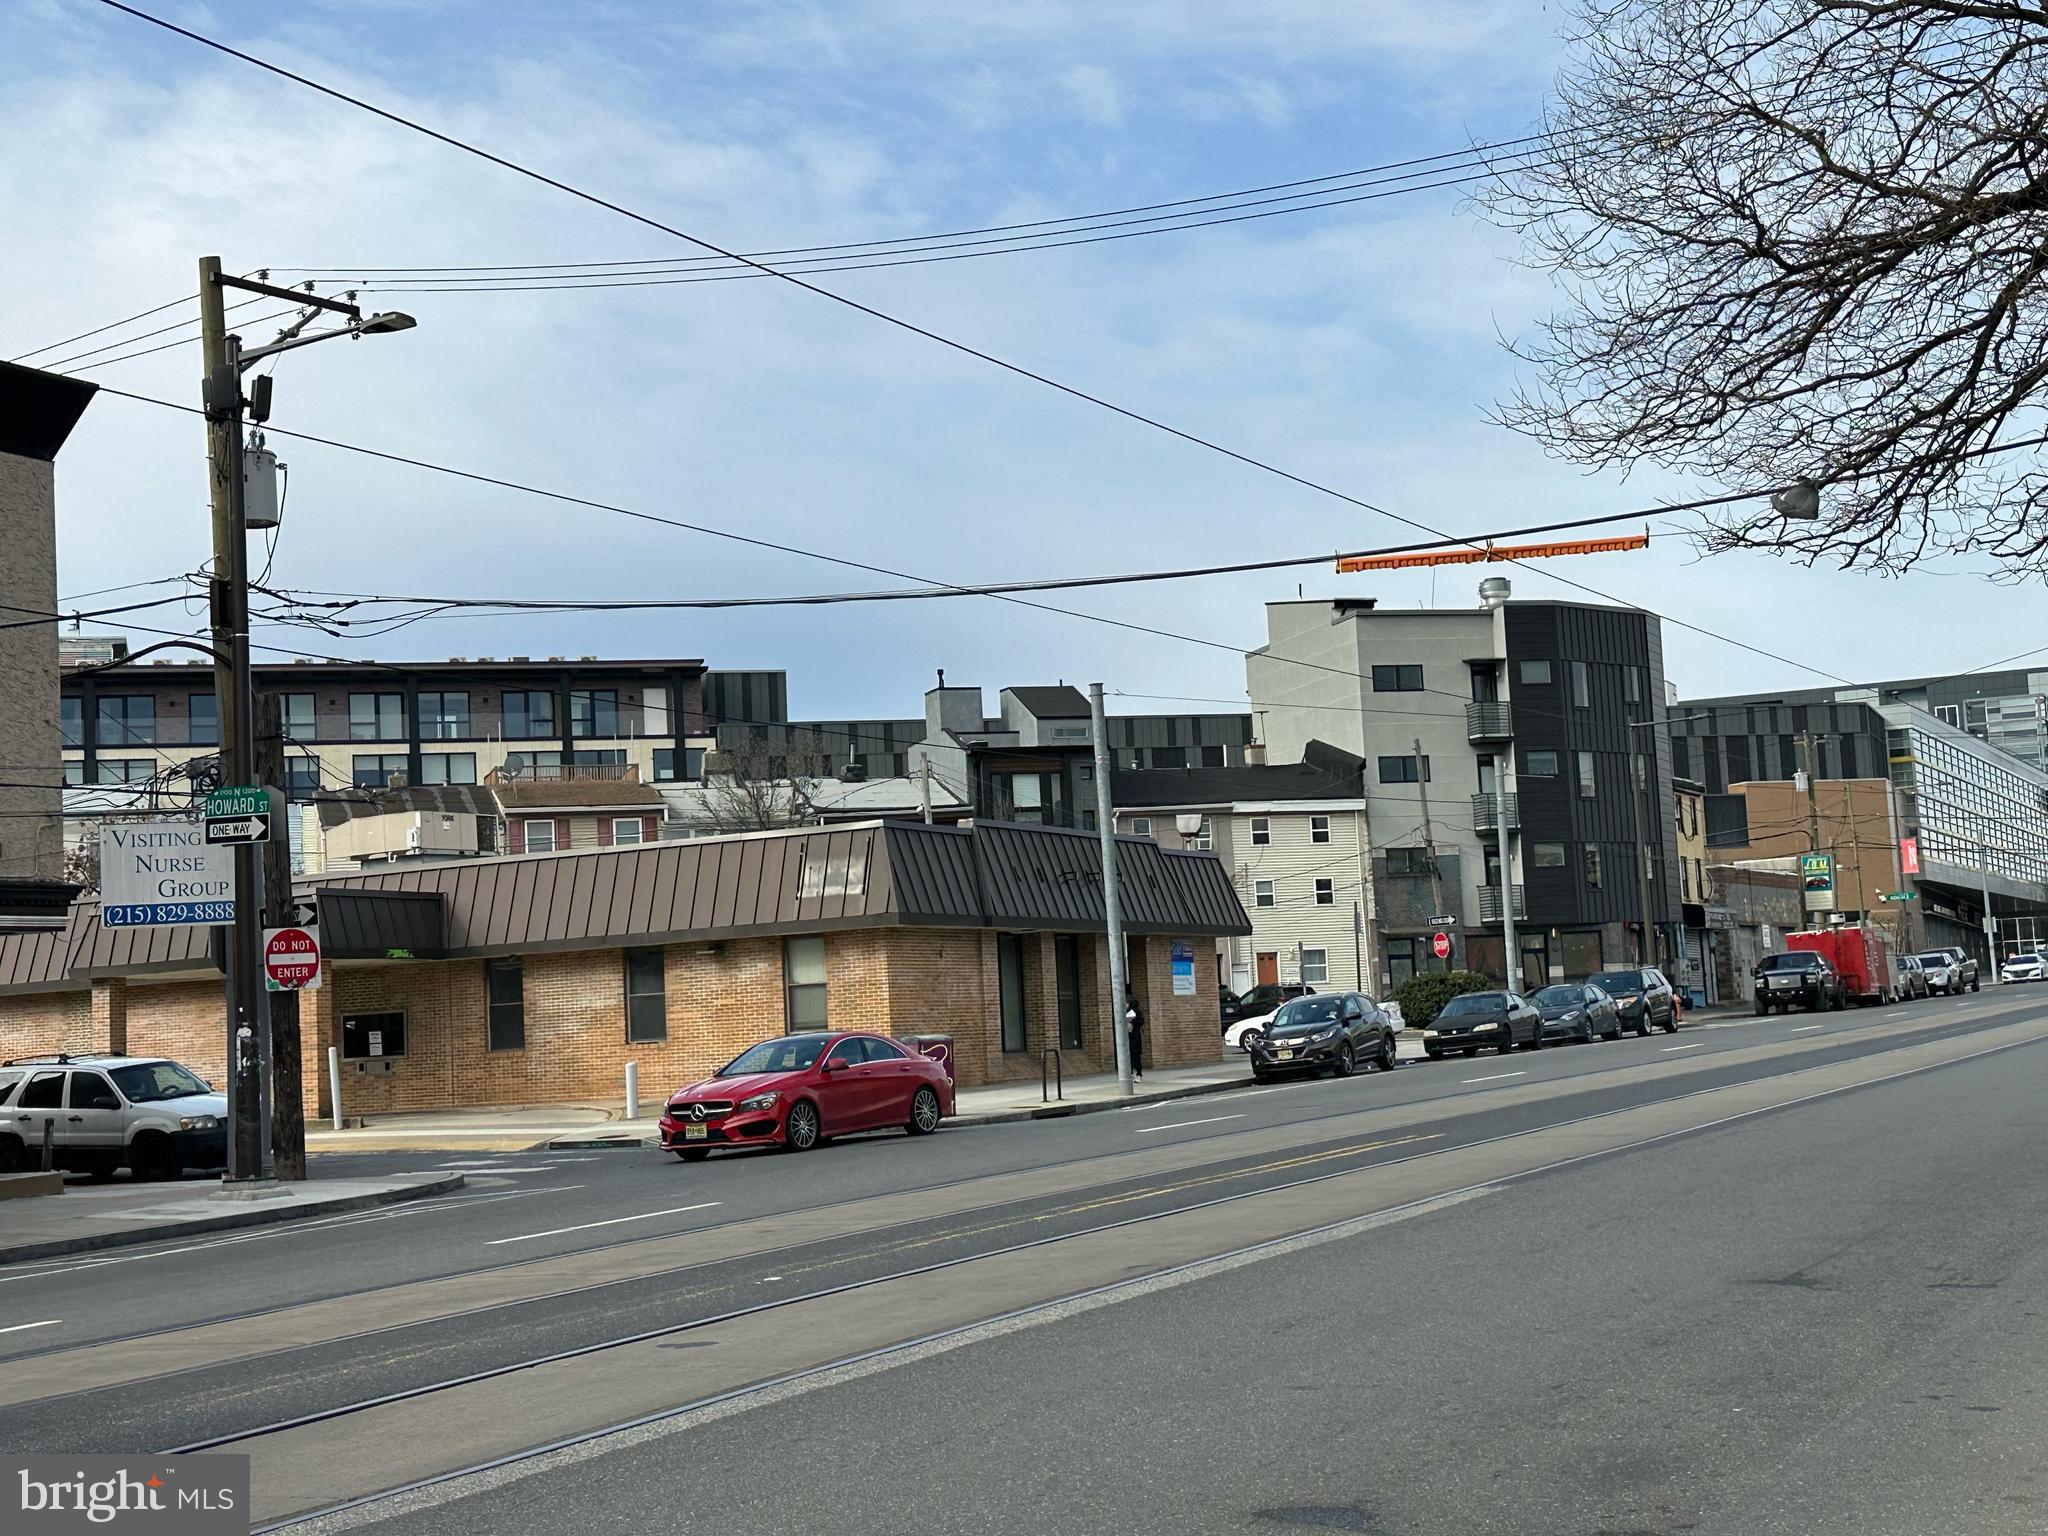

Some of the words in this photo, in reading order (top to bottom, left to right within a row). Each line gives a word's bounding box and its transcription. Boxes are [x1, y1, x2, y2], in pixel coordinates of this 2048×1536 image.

[207, 797, 255, 815] HOWARD
[259, 800, 269, 812] ST
[111, 829, 201, 848] VISITING
[212, 825, 230, 836] ONE
[232, 823, 251, 835] WAY
[135, 854, 205, 874] NURSE
[158, 879, 229, 898] GROUP
[106, 905, 151, 924] (215)
[156, 902, 235, 922] 829-8888
[272, 941, 286, 951] DO
[291, 940, 310, 950] NOT
[277, 966, 309, 977] ENTER
